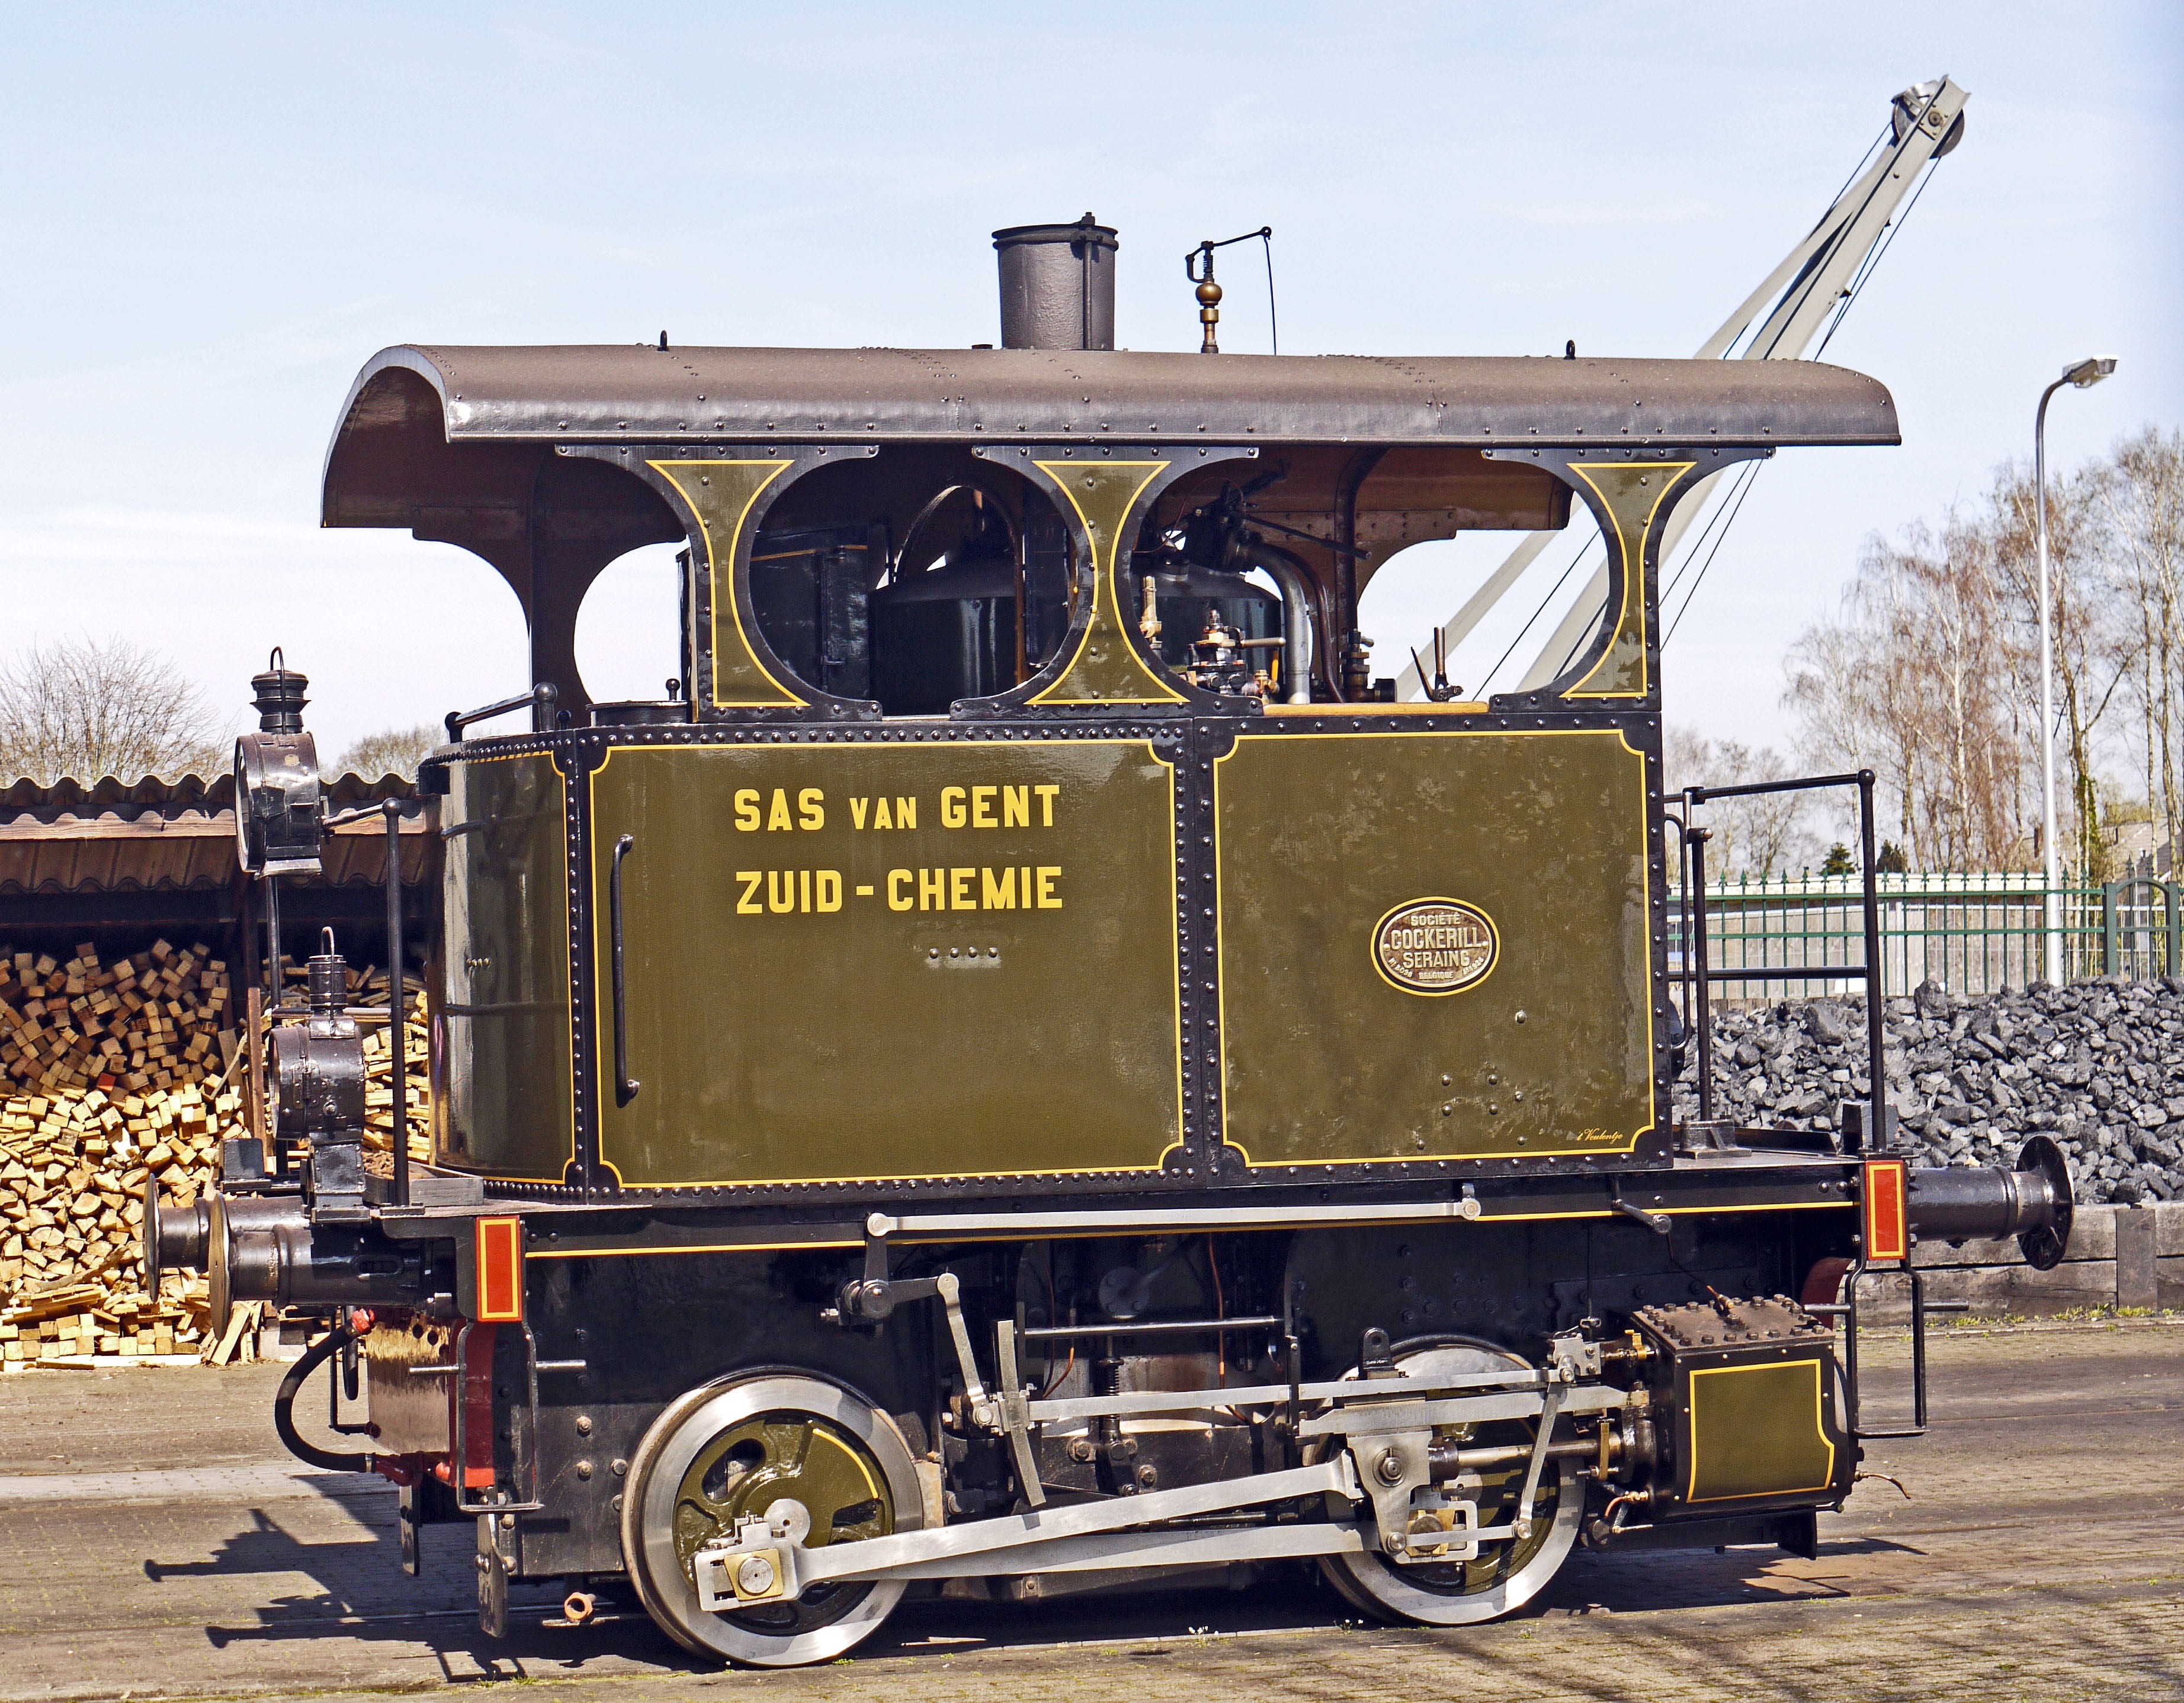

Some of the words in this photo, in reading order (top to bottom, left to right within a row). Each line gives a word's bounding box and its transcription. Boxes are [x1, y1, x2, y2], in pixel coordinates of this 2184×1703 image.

[734, 788, 825, 832] SAS
[849, 797, 916, 829] VAN
[941, 785, 1060, 828] GENT
[736, 870, 842, 914] ZUID
[887, 866, 1063, 911] CHEMIE
[1410, 912, 1461, 926] SOCIÉTÉ
[1391, 927, 1482, 950] COCKERILL
[1403, 950, 1470, 968] SERAING
[1419, 971, 1454, 980] BELGIQUE
